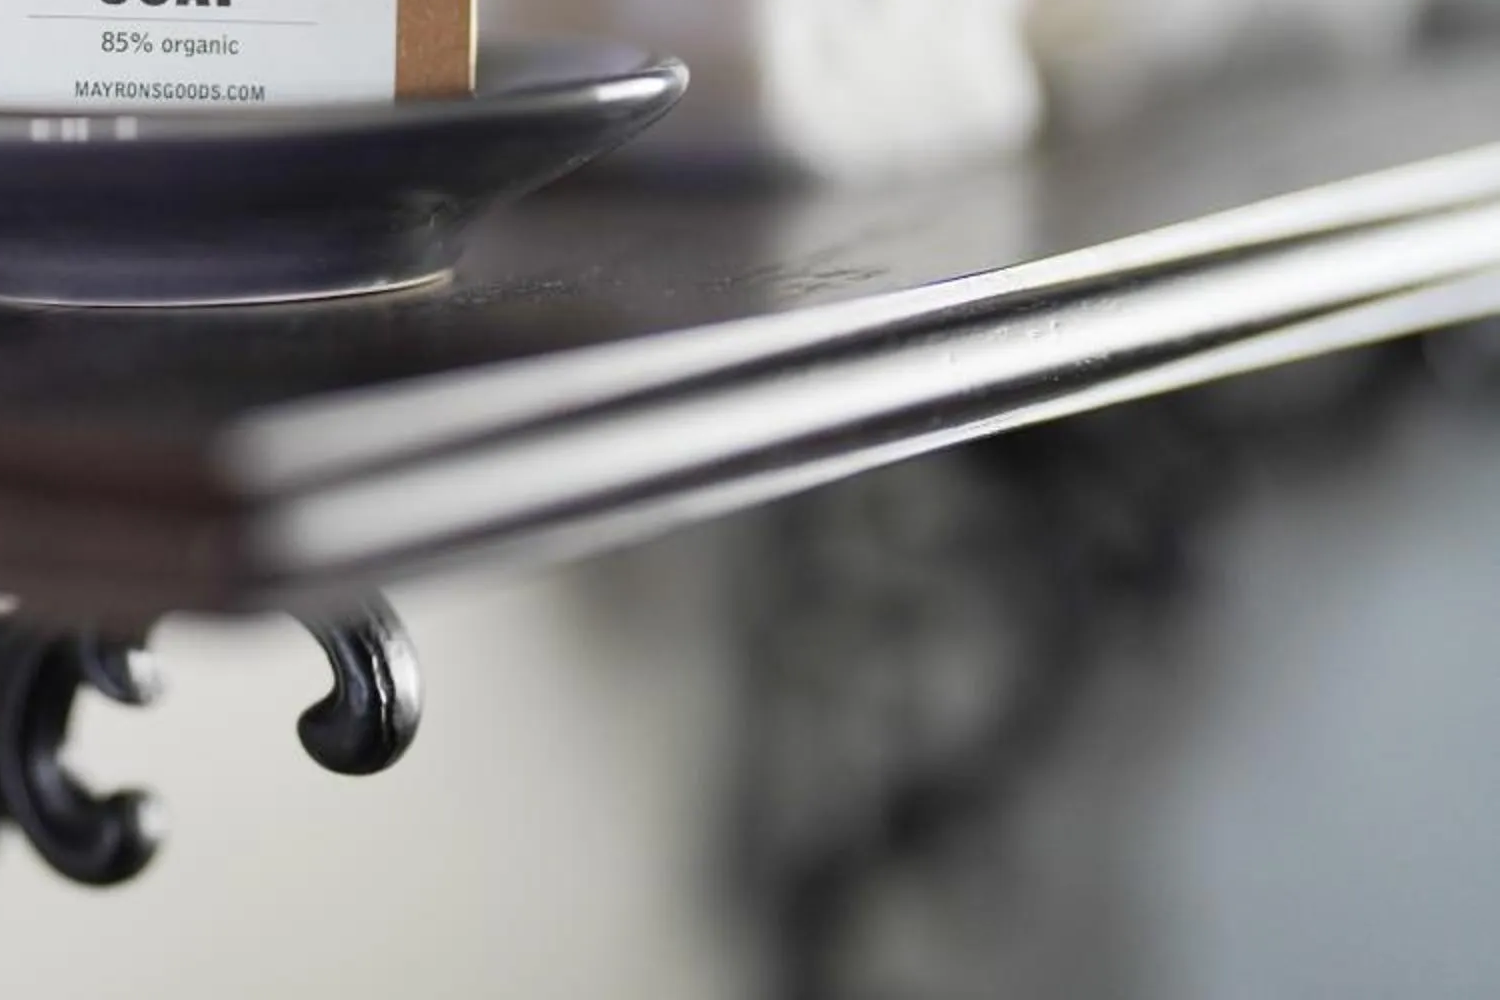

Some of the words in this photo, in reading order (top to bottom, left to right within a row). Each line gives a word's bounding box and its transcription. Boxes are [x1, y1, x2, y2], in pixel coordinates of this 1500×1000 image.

[101, 31, 153, 54] 85%
[161, 35, 240, 58] organic
[74, 80, 267, 102] MAYRONSGOODS.COM
